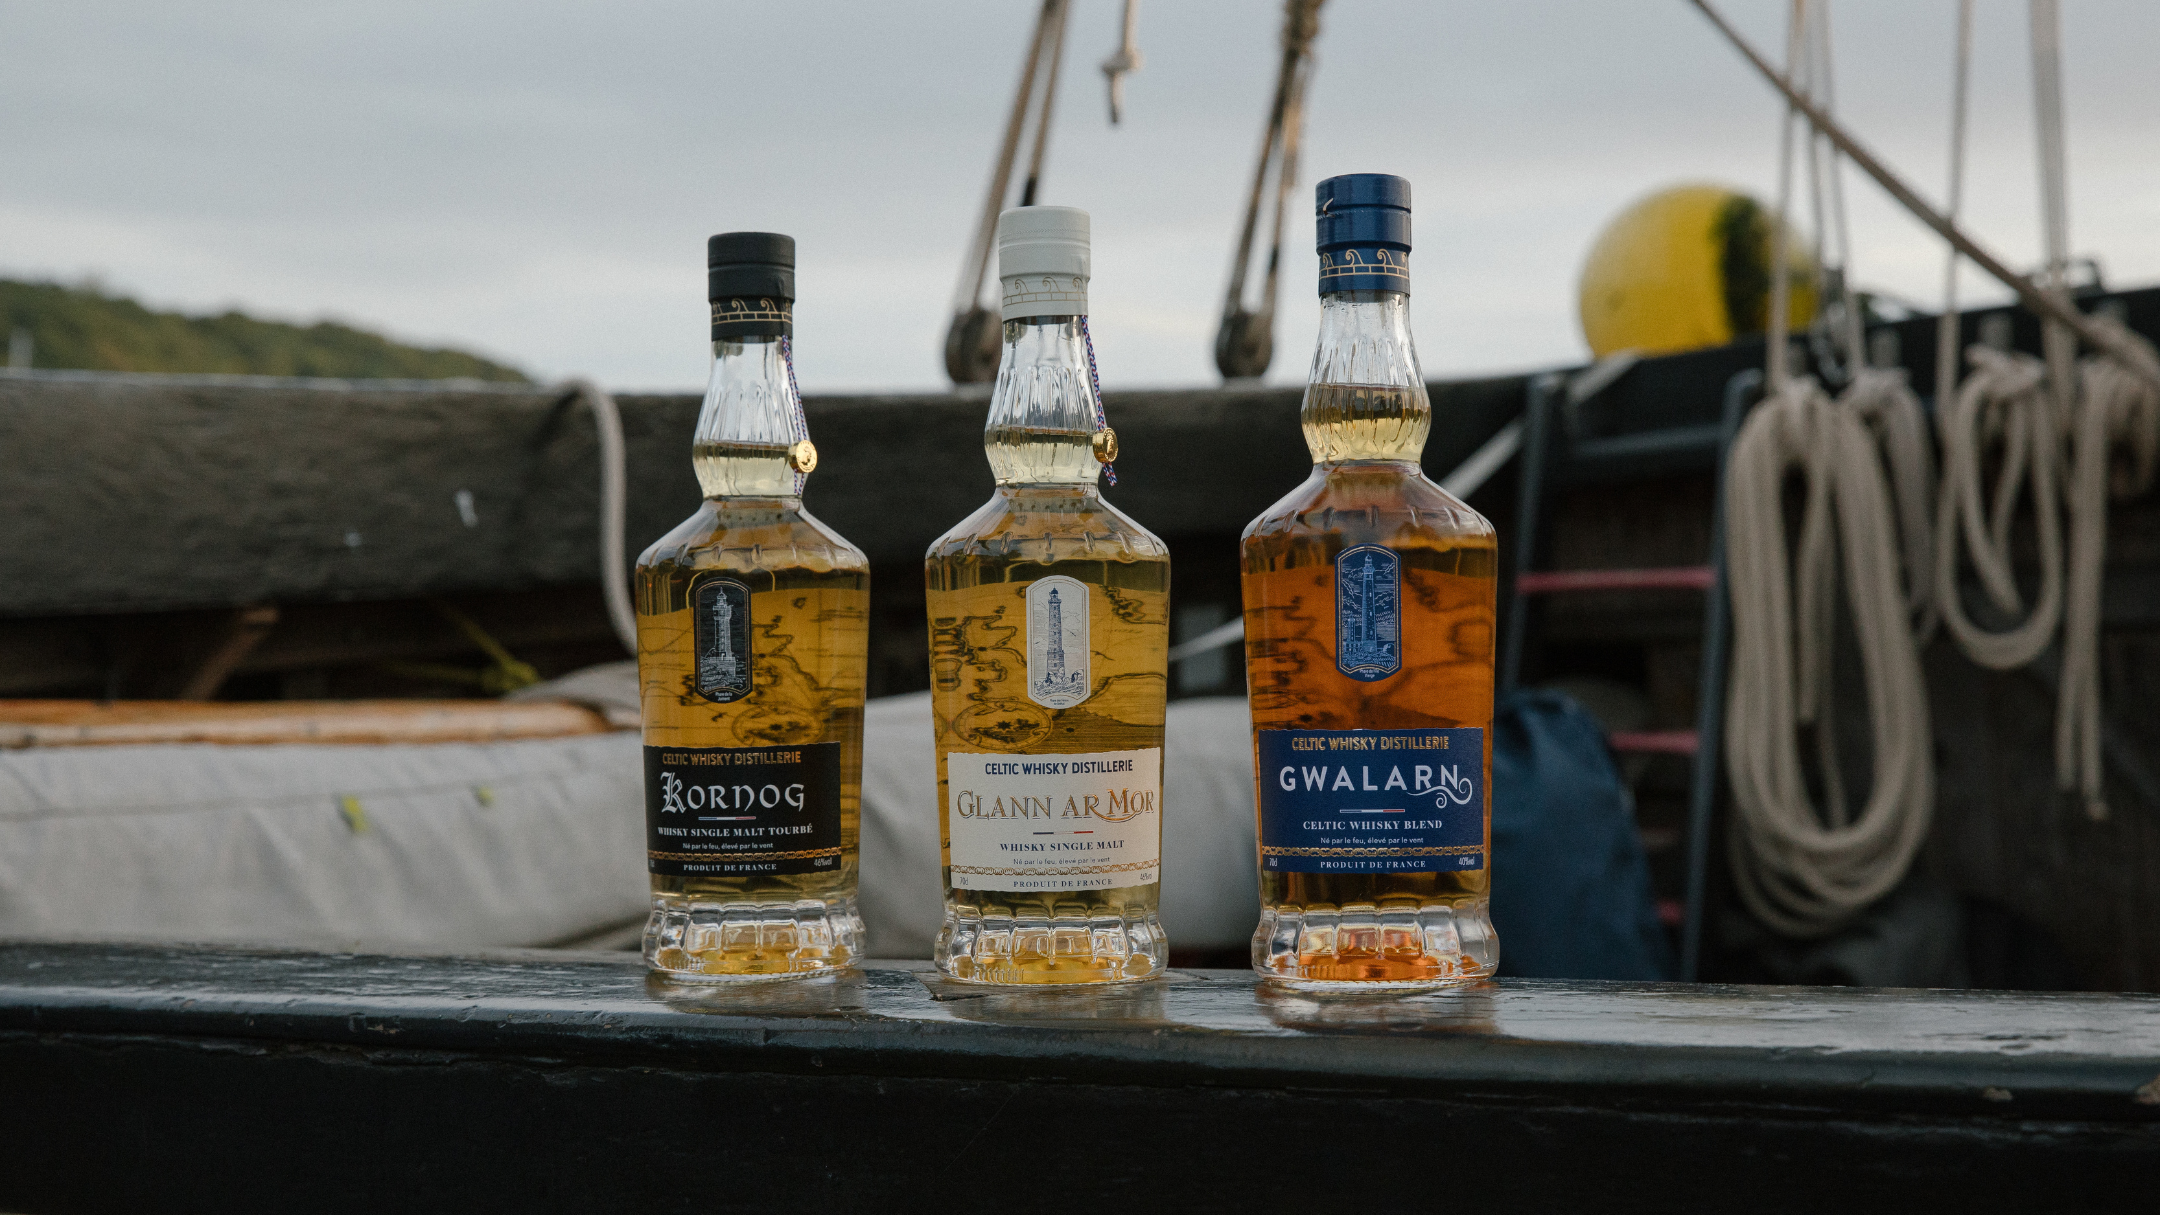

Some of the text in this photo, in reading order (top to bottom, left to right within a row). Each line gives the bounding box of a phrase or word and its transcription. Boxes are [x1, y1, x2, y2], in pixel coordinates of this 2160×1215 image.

[1292, 736, 1449, 751] CELTIC WHISKY DISTILLERIE
[663, 751, 801, 765] CELTIC WHISKY DISTILLERIE
[985, 760, 1133, 775] CELTIC WHISKY DISTILLERIE
[1279, 765, 1472, 809] GWALARN
[658, 823, 813, 837] WHISKY SINGLE MALT TOURBÉ
[1303, 820, 1442, 830] CELTIC WHISKY BLEND
[1000, 840, 1125, 851] WHISKY SINGLE MALT
[1353, 837, 1366, 845] feu,
[739, 863, 776, 871] FRANCE
[1320, 861, 1366, 869] PRODUIT
[1077, 878, 1113, 887] FRANCE
